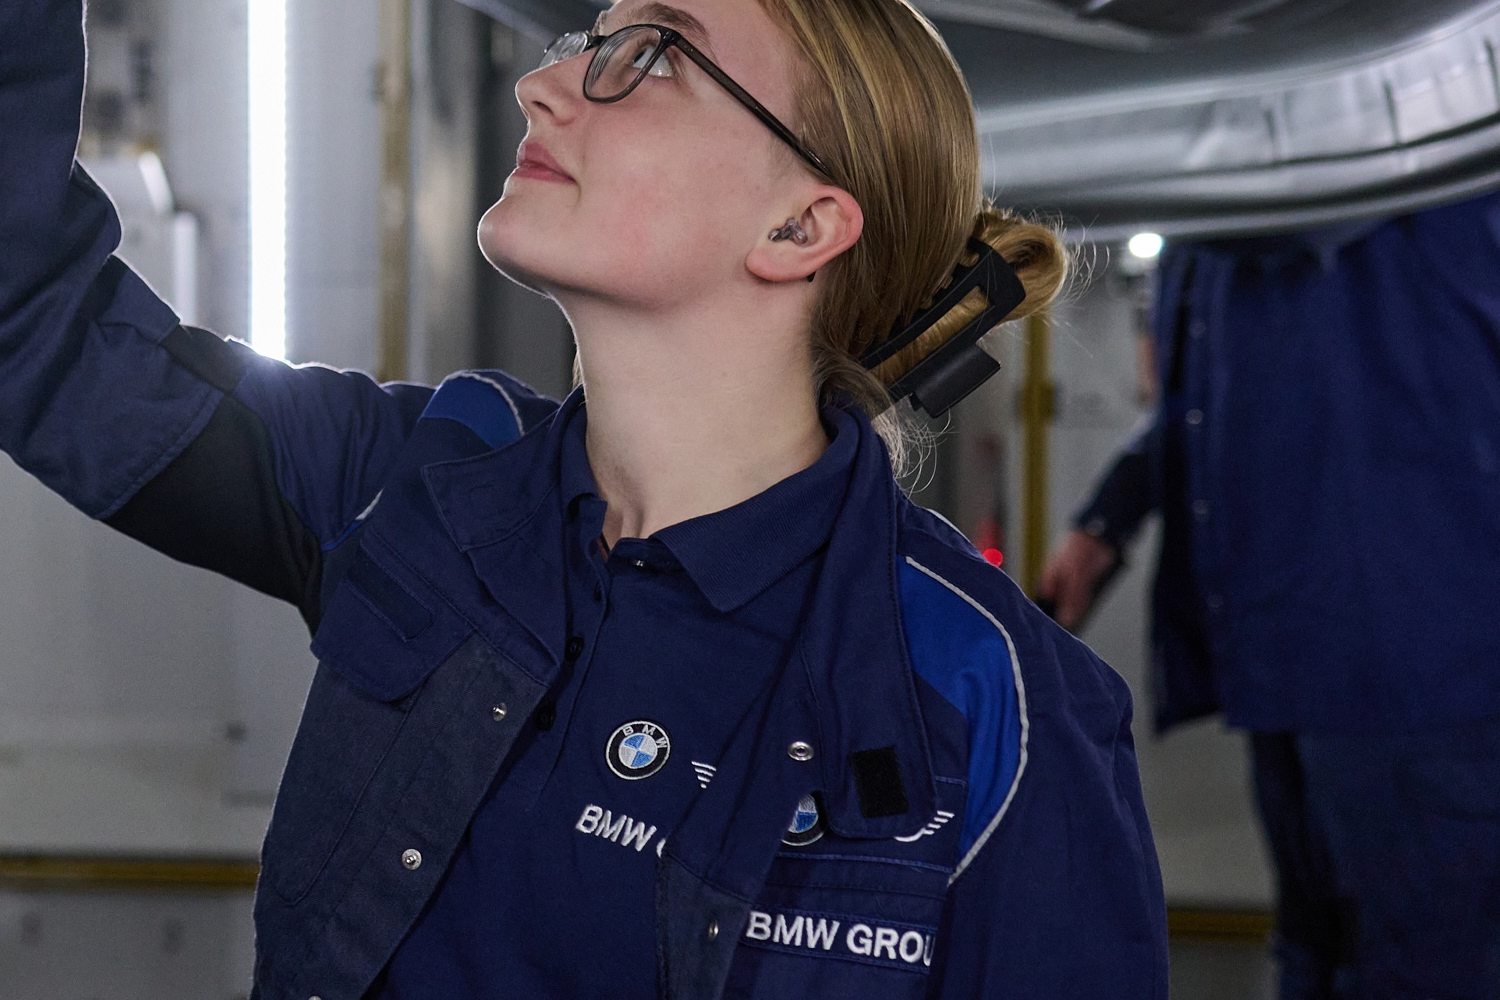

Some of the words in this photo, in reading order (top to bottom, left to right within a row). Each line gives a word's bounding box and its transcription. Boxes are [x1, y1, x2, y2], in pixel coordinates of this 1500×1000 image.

[622, 724, 668, 749] BMW
[575, 804, 657, 852] BMW
[746, 911, 840, 950] BMW
